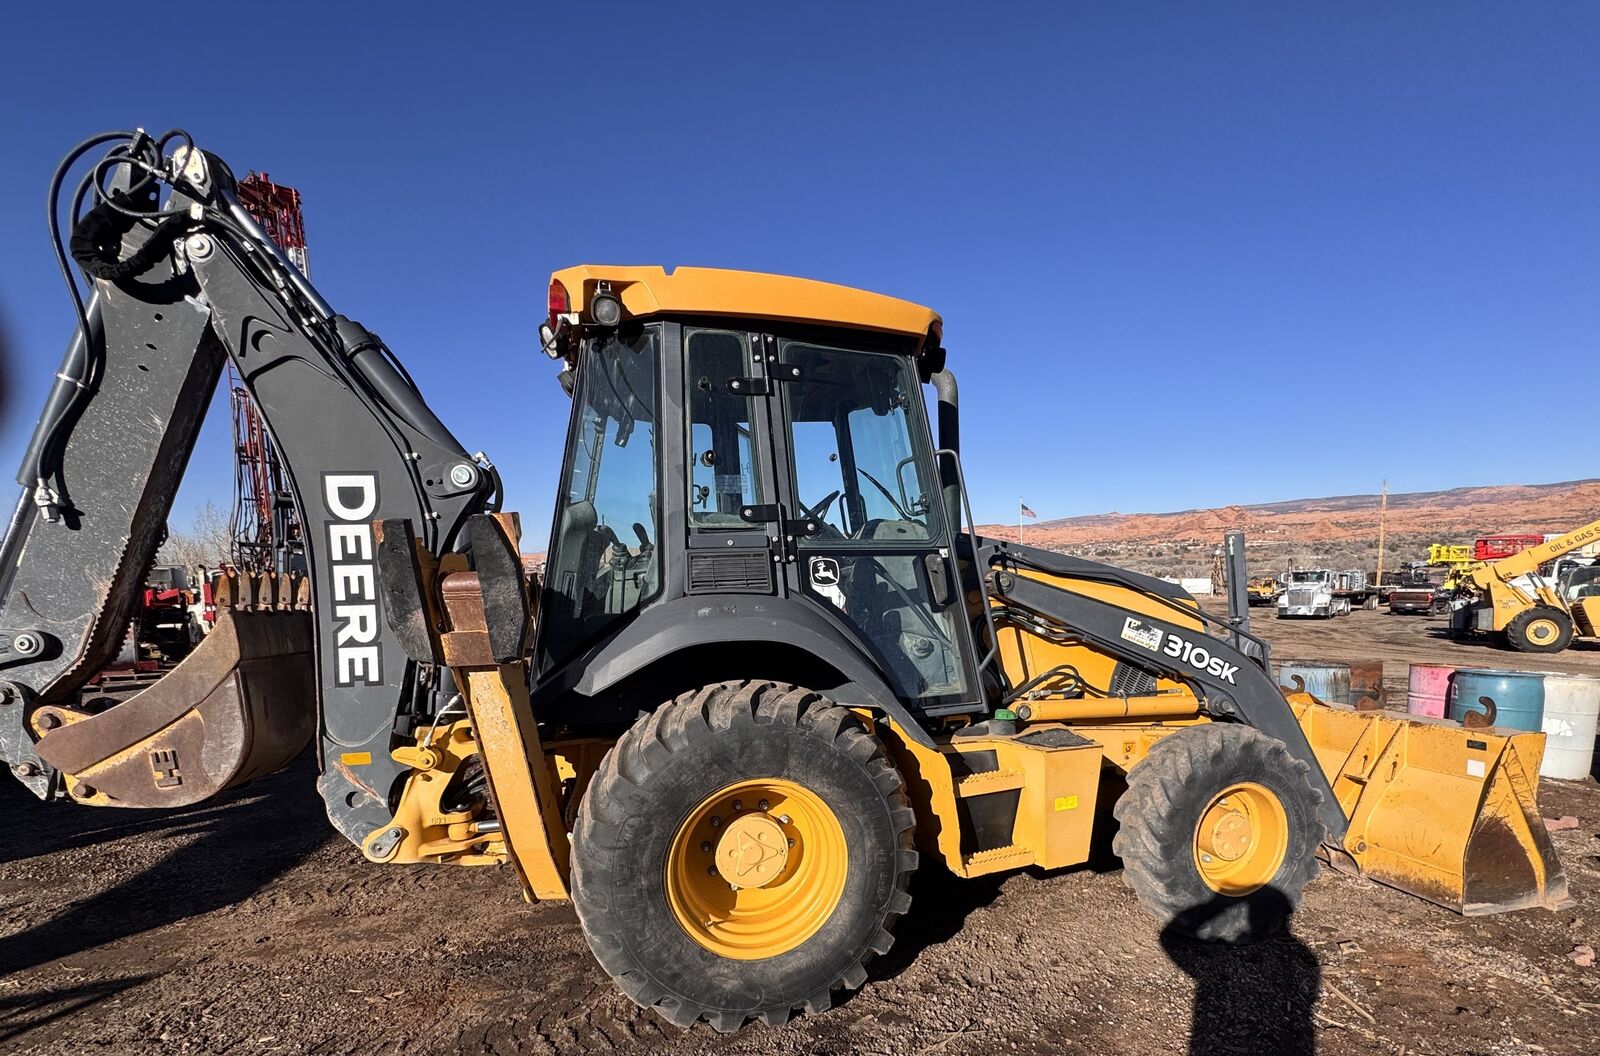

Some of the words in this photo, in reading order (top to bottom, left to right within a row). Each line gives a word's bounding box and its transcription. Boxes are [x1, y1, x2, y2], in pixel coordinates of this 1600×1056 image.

[1550, 543, 1566, 552] OIL
[1574, 530, 1594, 542] GAS
[324, 474, 380, 684] DEERE
[1163, 634, 1240, 685] 310SK
